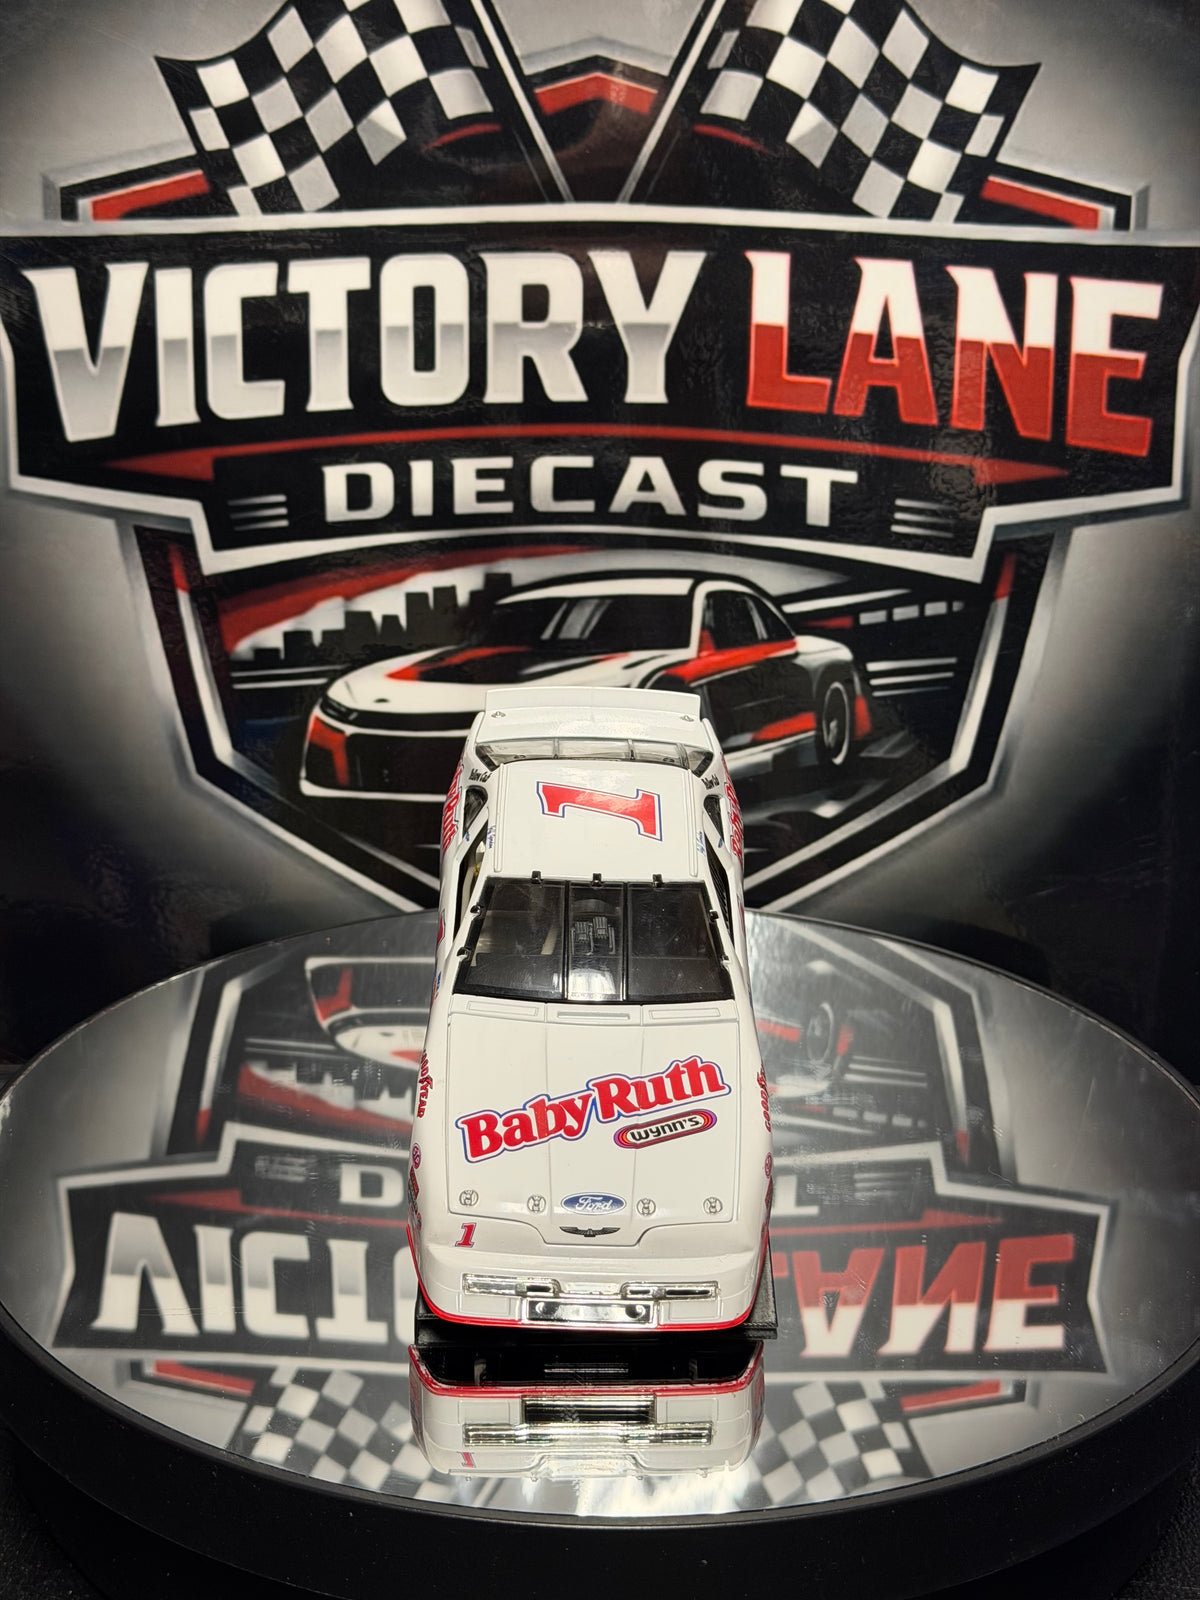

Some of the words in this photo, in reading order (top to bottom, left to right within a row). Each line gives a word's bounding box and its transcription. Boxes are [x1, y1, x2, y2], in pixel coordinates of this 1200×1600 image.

[21, 250, 708, 443] VICTORY
[744, 250, 1164, 457] LANE
[321, 455, 858, 527] DIECAST
[536, 780, 663, 842] 1
[416, 1049, 434, 1118] OODYEAR
[459, 1093, 593, 1159] Baby
[591, 1057, 726, 1120] Ruth
[455, 1222, 477, 1248] 1
[575, 1196, 613, 1211] Ford
